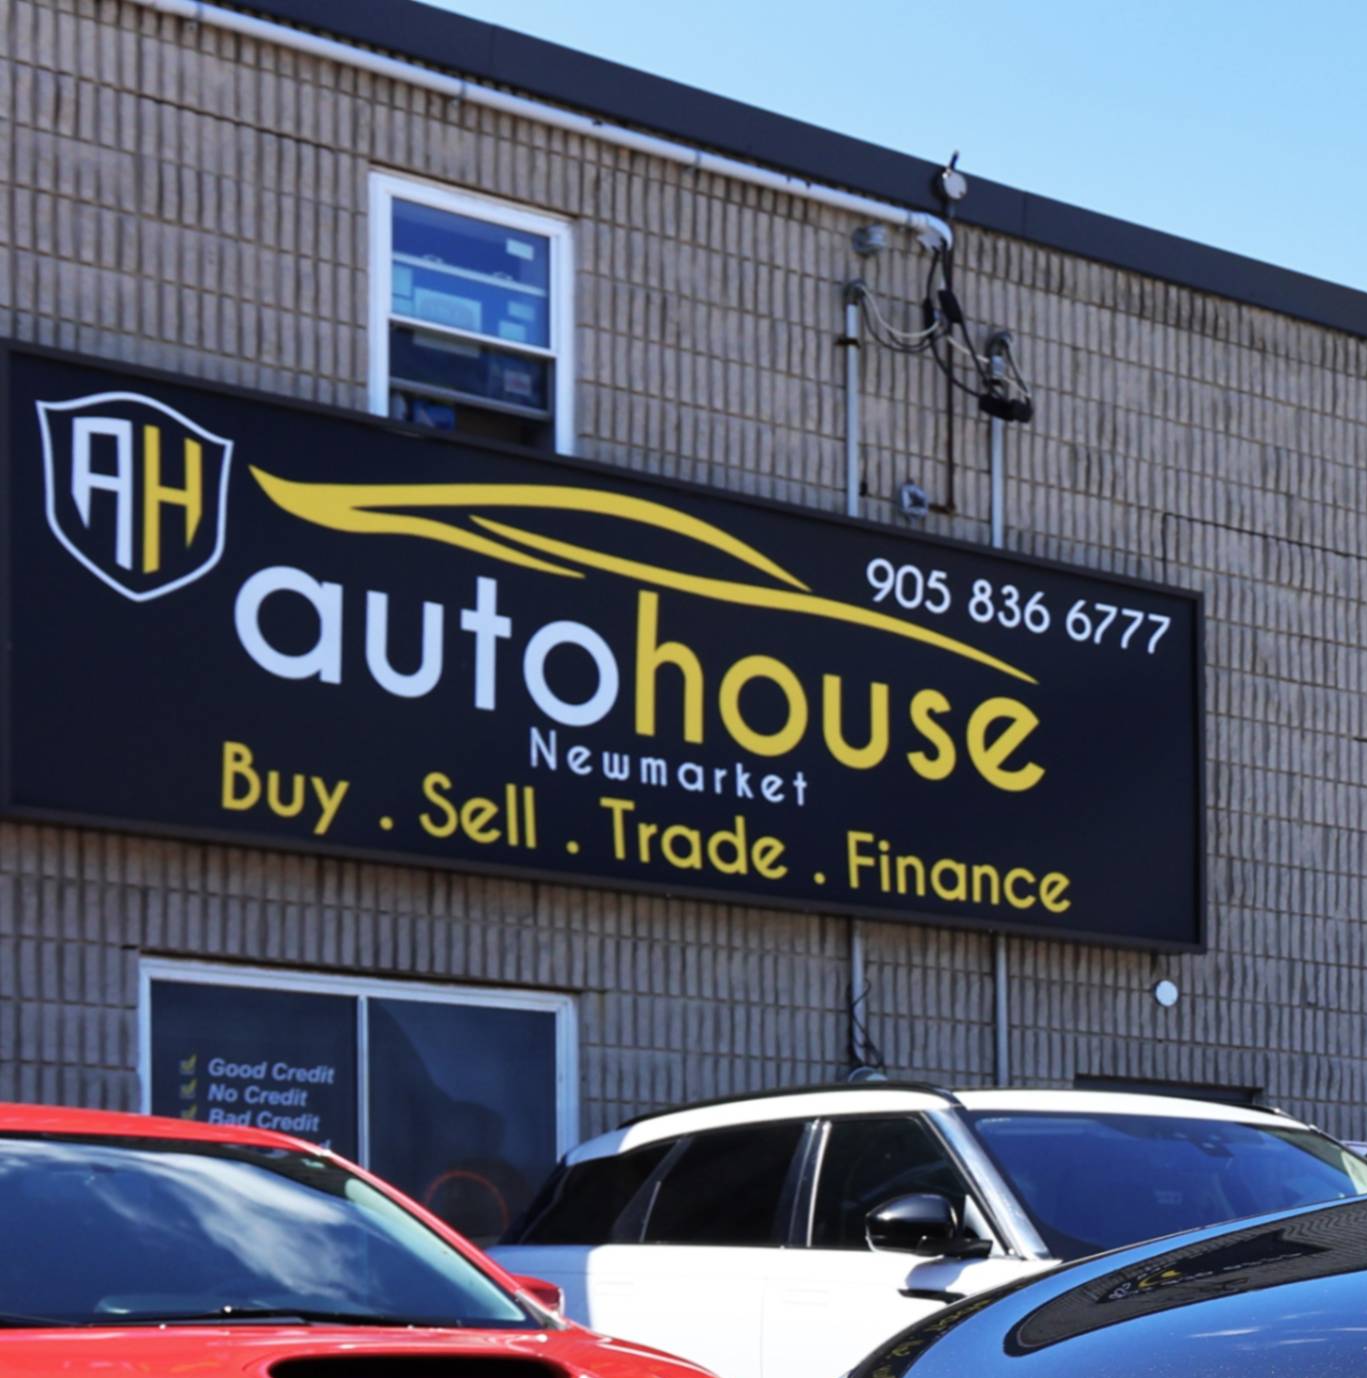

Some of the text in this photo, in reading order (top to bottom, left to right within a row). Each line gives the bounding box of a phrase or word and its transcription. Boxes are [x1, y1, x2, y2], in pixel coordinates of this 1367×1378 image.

[72, 416, 202, 574] AH
[866, 558, 1171, 654] 905 836 6777
[234, 565, 1046, 792] autohouse
[530, 727, 807, 806] Newmarket
[222, 741, 349, 835] Buy
[419, 772, 537, 849] Sell
[600, 797, 788, 880] Trade
[847, 831, 1072, 913] Finance
[207, 1058, 335, 1084] Good Credit
[207, 1084, 308, 1107] No Credit
[208, 1108, 320, 1132] Bad Credit
